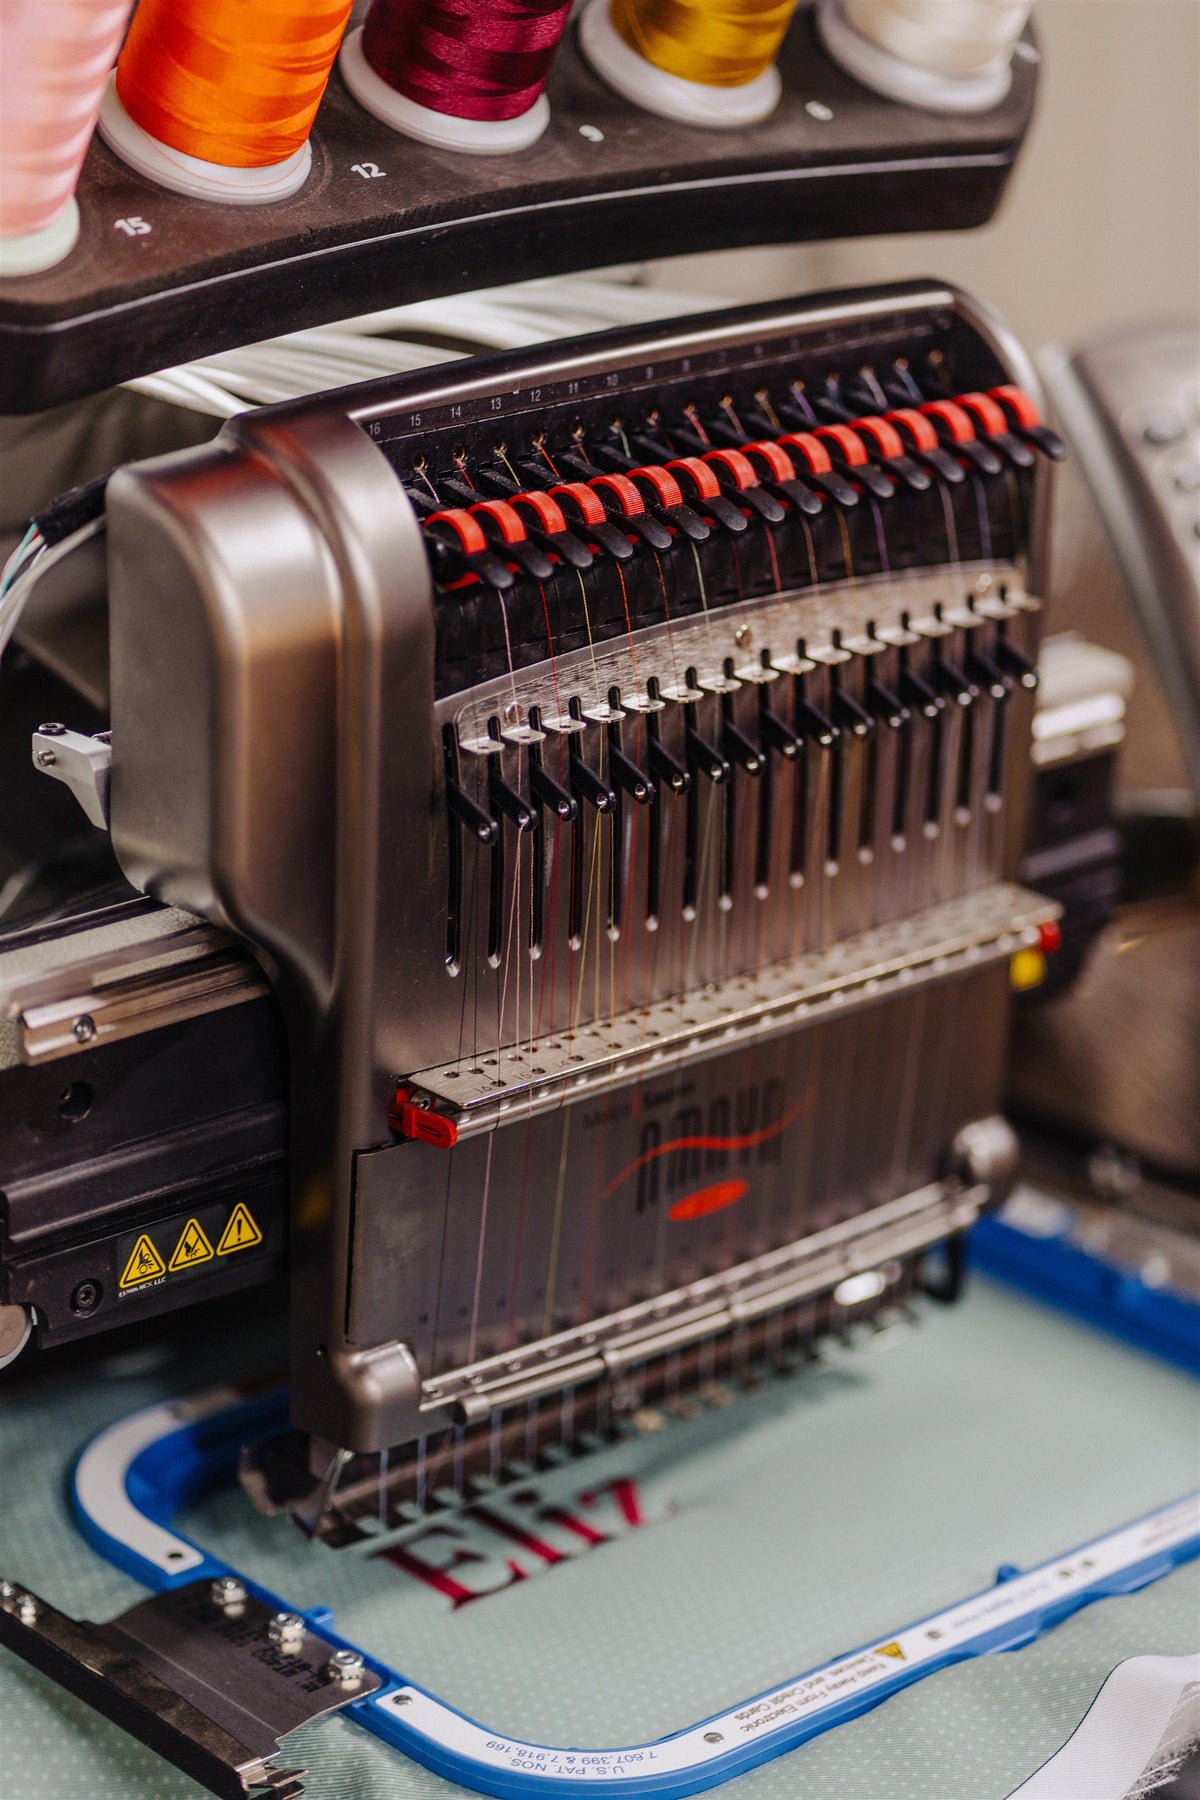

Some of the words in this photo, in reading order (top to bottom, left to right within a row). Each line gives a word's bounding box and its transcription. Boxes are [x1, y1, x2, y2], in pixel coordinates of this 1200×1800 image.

[350, 162, 388, 180] 12
[113, 216, 152, 237] 15
[369, 422, 381, 436] 16
[409, 414, 422, 428] 15
[450, 405, 462, 419] 14
[490, 397, 502, 411] 13
[530, 389, 542, 403] 12
[568, 382, 580, 395] 11
[770, 1686, 805, 1706] Credit
[798, 1691, 829, 1706] From
[734, 1702, 771, 1721] Cards
[739, 1704, 798, 1732] Electronic
[485, 1740, 562, 1762] 7,918,169
[581, 1750, 658, 1765] 7,607,399
[509, 1756, 547, 1771] NOS.
[554, 1764, 586, 1775] PAT.
[565, 1756, 576, 1765] &
[592, 1765, 625, 1776] U.S.
